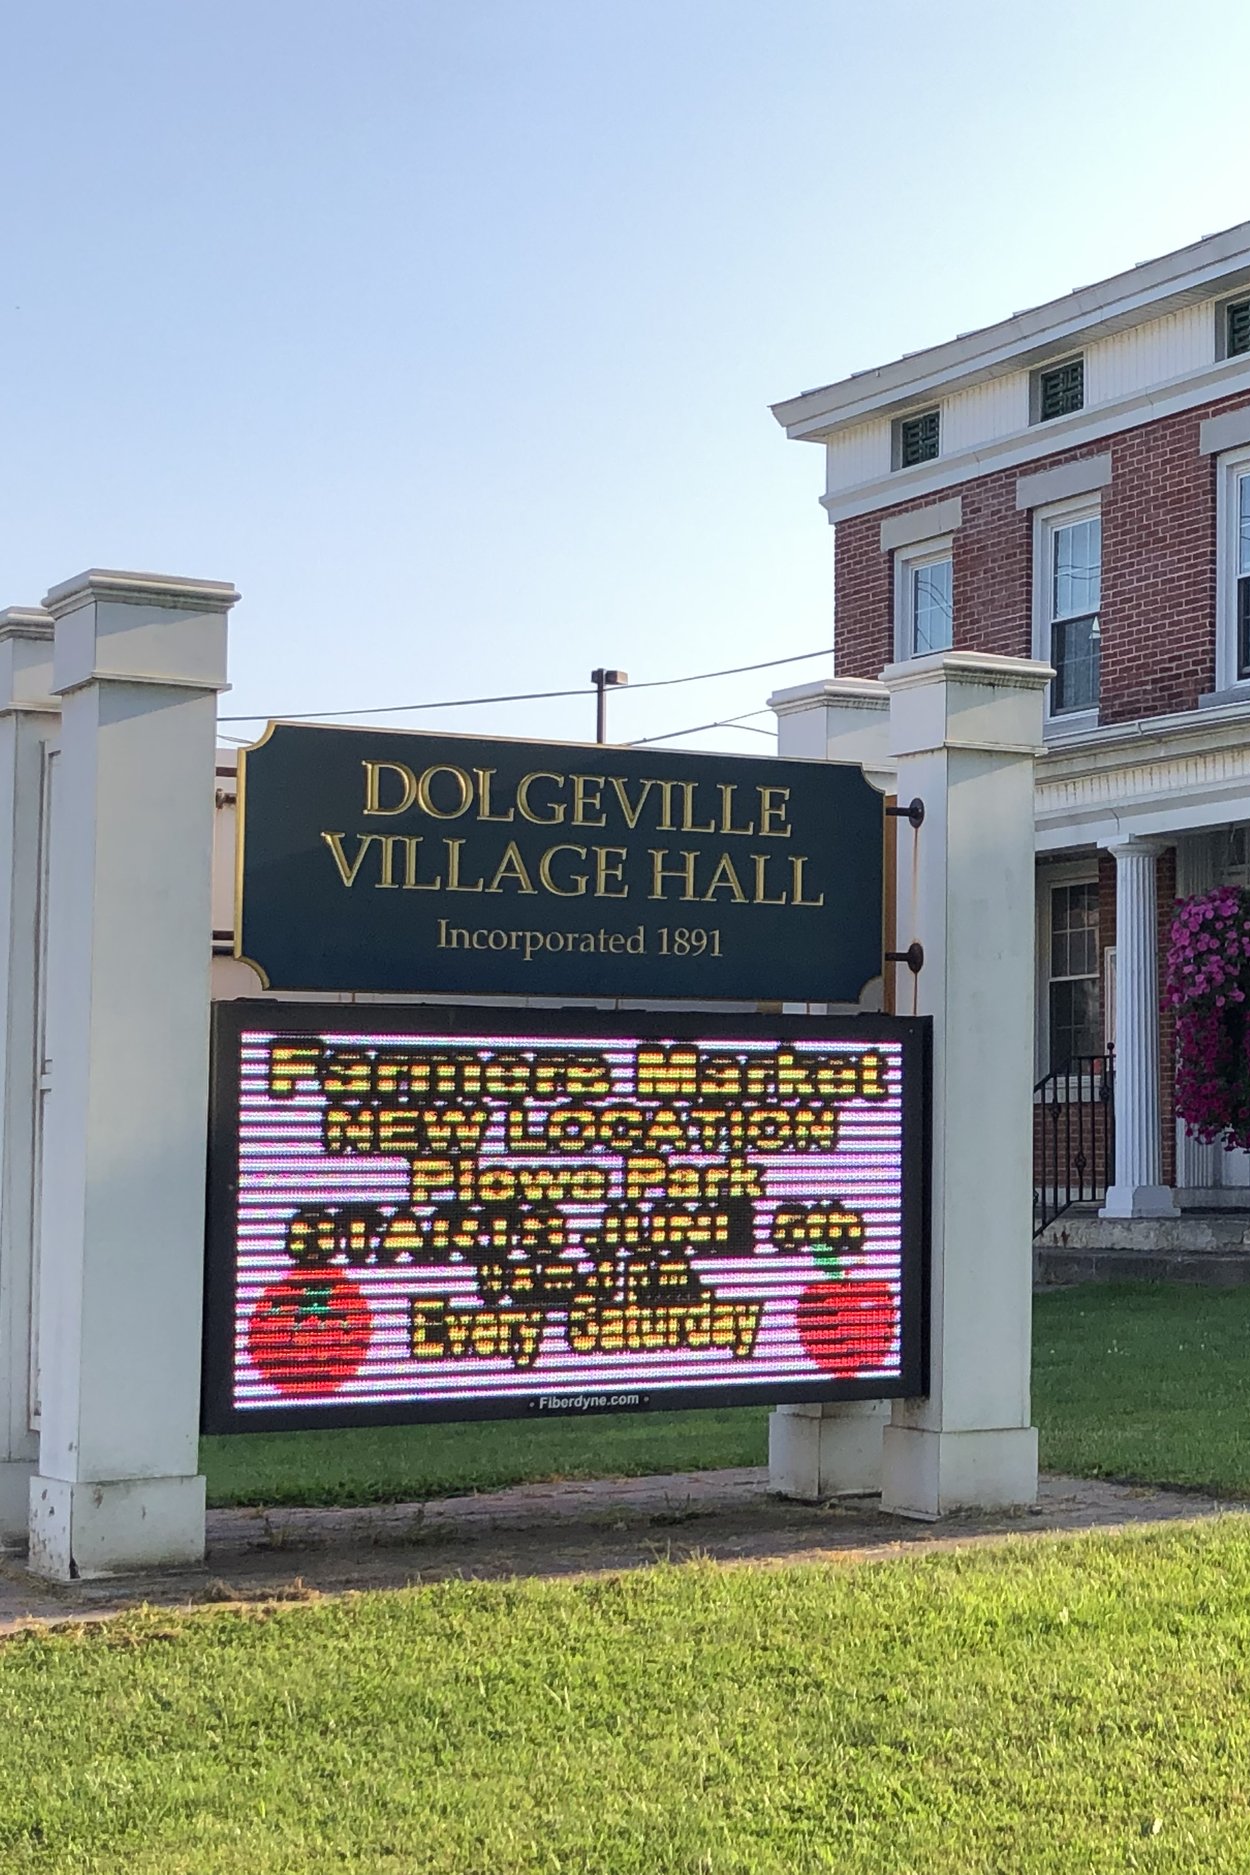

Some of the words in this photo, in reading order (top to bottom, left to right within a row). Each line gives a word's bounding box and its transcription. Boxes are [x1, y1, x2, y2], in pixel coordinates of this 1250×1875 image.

[361, 759, 792, 838] DOLGEVILLE
[320, 831, 629, 897] VILLAGE
[648, 848, 824, 906] HALL
[437, 918, 646, 961] Incorporated
[657, 927, 723, 957] 1891
[270, 1043, 610, 1096] Farmers
[636, 1046, 887, 1096] Market
[326, 1107, 488, 1153] NEW
[508, 1106, 836, 1151] LOCATION
[626, 1154, 763, 1200] Park
[412, 1299, 545, 1367] Every
[568, 1292, 761, 1358] Saturday
[539, 1394, 640, 1411] Fiberdyne.com
